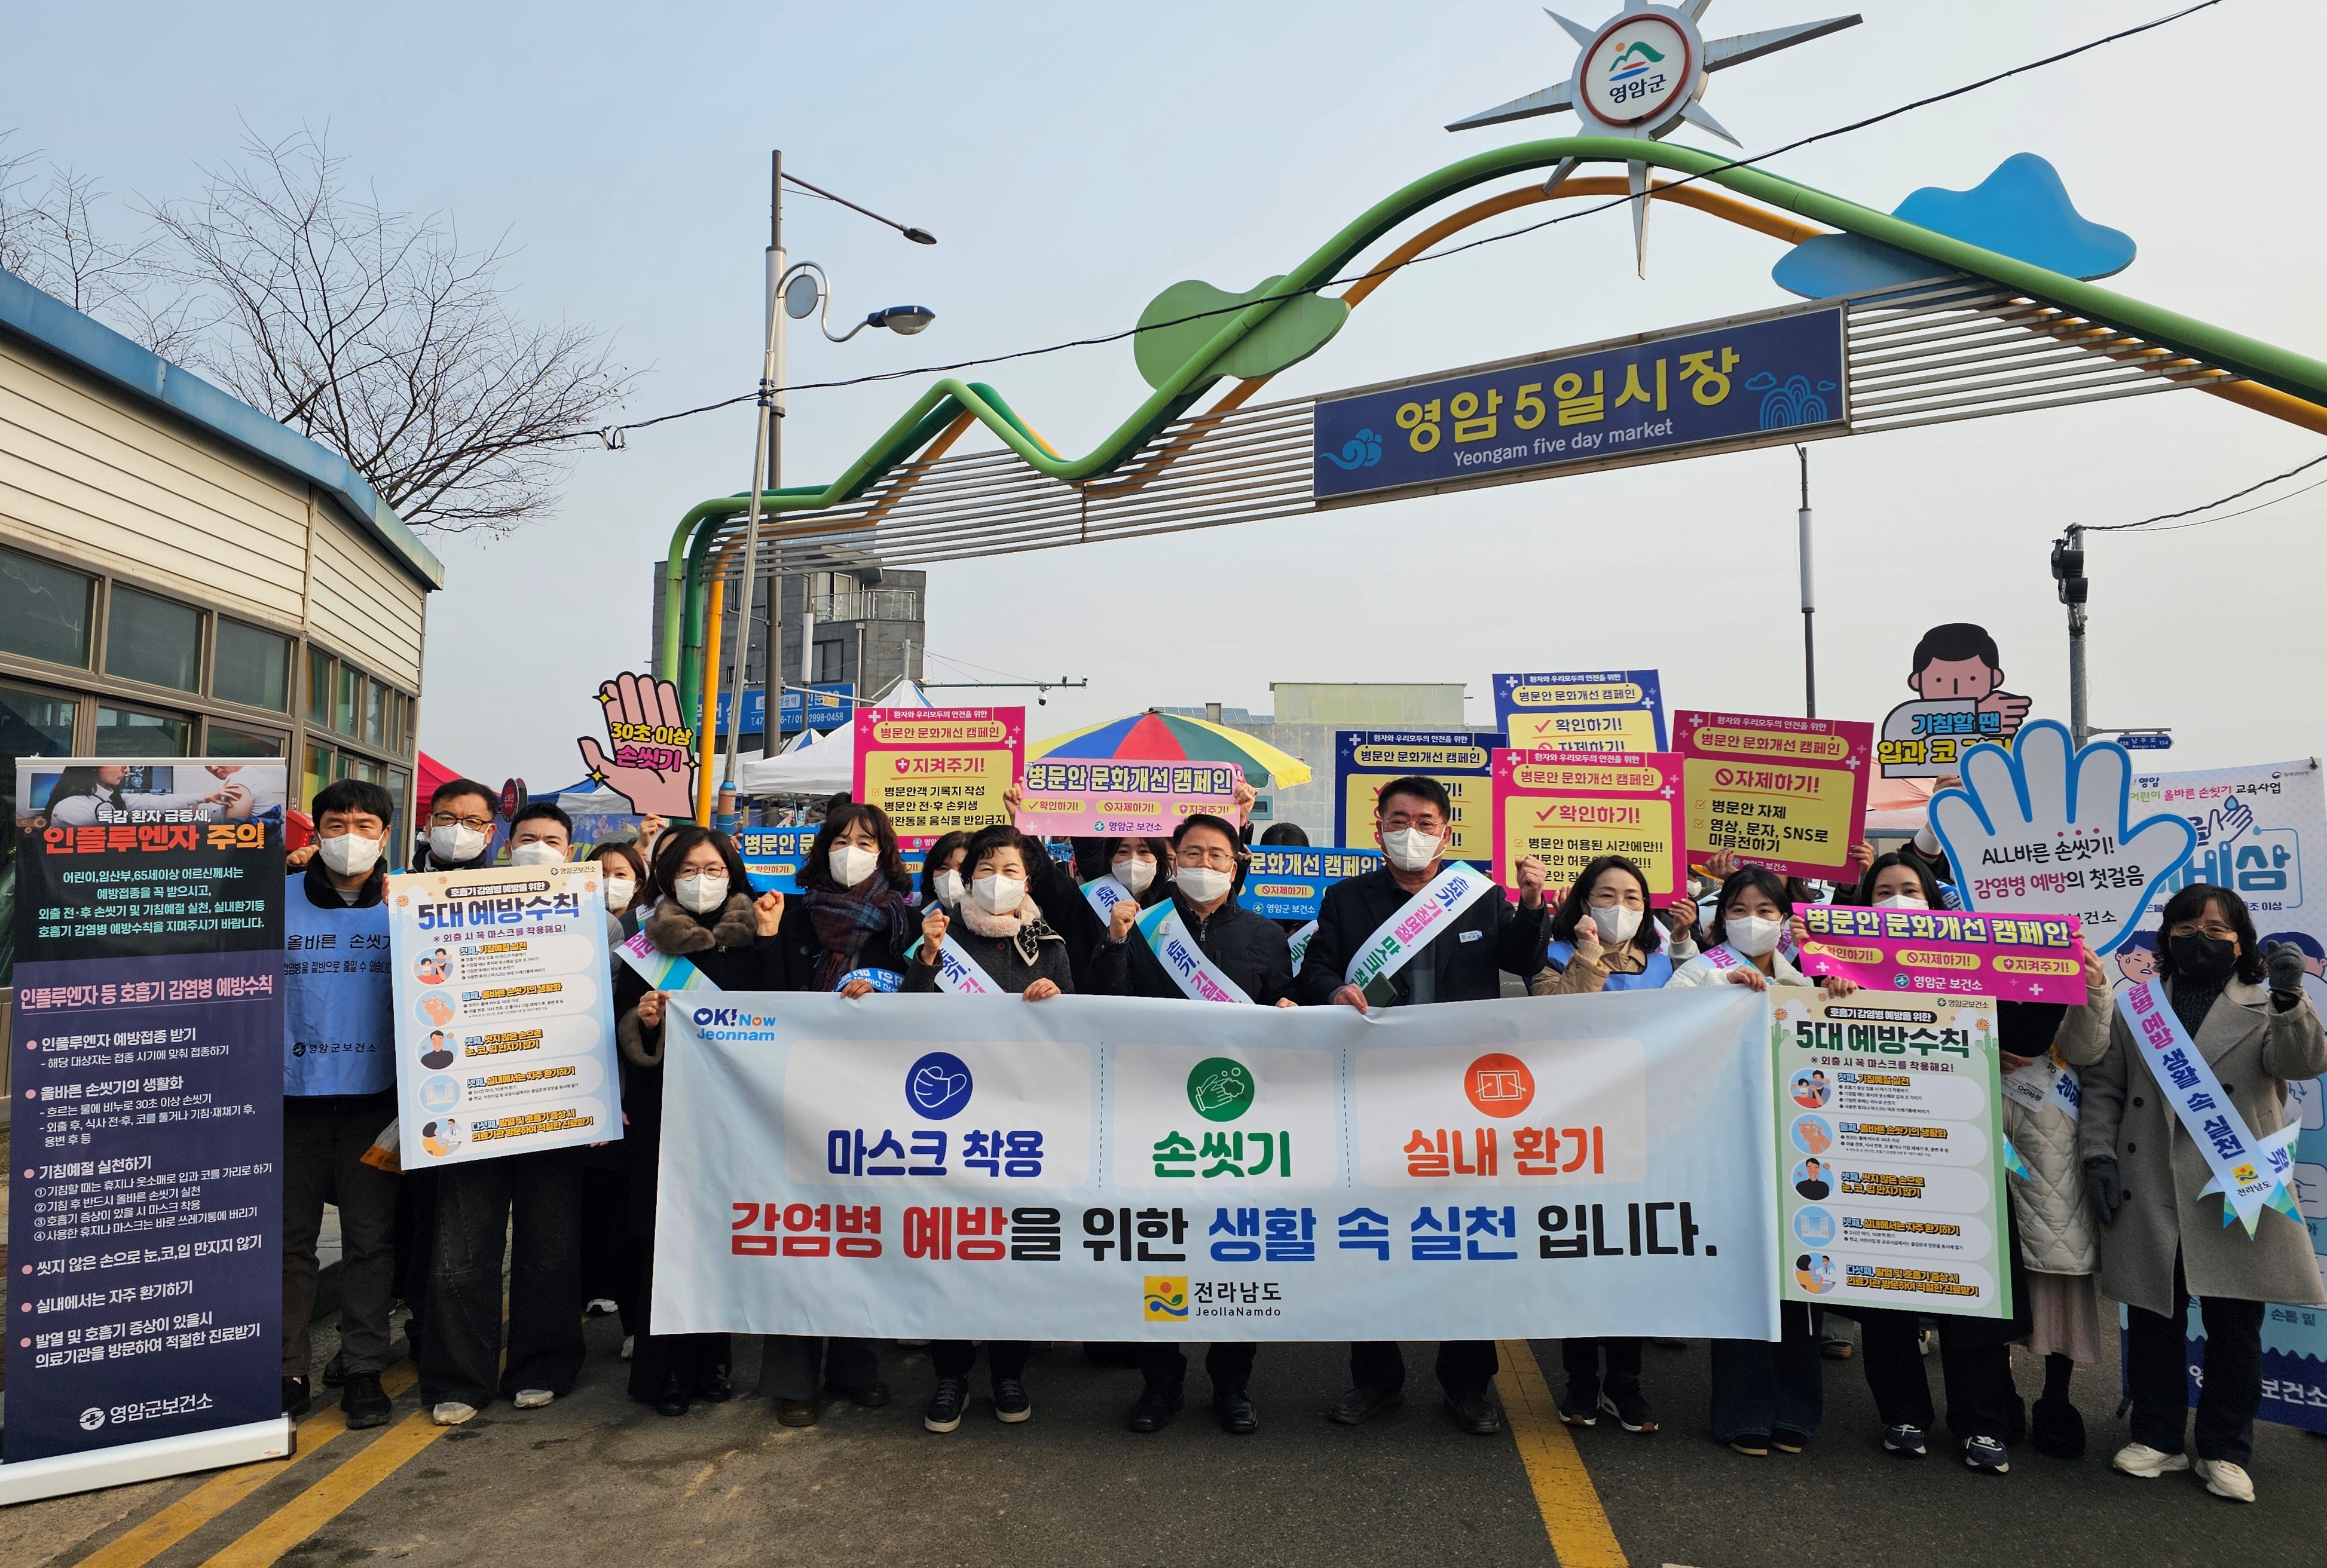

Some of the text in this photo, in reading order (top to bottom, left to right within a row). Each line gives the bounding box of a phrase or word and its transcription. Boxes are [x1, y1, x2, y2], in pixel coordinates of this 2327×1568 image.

[1610, 74, 1666, 103] 영암군
[1453, 417, 1674, 467] Yeongam five day market
[1519, 688, 1635, 702] 병문안 문화개선 캠페인
[880, 726, 999, 738] 병문안 문화개선 캠페인
[1556, 717, 1622, 732] 확인하기!
[1913, 712, 2000, 735] 기침할 땐
[611, 723, 692, 746] 30초 이상
[1701, 733, 1840, 755] 병문안 문화개선 캠페인
[616, 746, 682, 771] 손씻기
[1878, 740, 1957, 765] 입과 코
[913, 758, 984, 773] 지켜주기!
[1027, 764, 1233, 795] 병문안 문화개선 캠페인
[1735, 770, 1820, 794] 자제하기!
[2139, 777, 2160, 788] 영암
[885, 786, 985, 797] 병문안객 기록지 작성
[2164, 789, 2195, 801] 올바른
[2199, 785, 2232, 798] 손씻기
[2236, 782, 2281, 794] 교육사업
[885, 801, 978, 811] 병문안 전·후 손위생
[1039, 801, 1079, 811] 확인하기!
[1114, 802, 1154, 812] 자제하기!
[1559, 806, 1640, 823] 확인하기!
[1712, 800, 1787, 819] 병문안 자제
[98, 809, 211, 823] 독감 환자 급증세,
[1109, 822, 1162, 832] 영암군 보건소
[1710, 819, 1828, 843] 영상, 문자, SNS로
[43, 821, 265, 855] 인플루엔자 주의
[1528, 838, 1663, 853] 병문안 허용된 시간에만!!
[1708, 834, 1780, 853] 마음전하기
[1982, 837, 2115, 865] ALL바른 손씻기!
[560, 866, 596, 875] 영암군보건소
[1249, 852, 1319, 877] 문화개선
[451, 882, 545, 897] 호흡기 감염병 예방을 위한
[1271, 886, 1307, 896] 자제하기!
[1974, 865, 2145, 899] 감염병 예방의 첫걸음
[418, 893, 579, 930] 5대 예방수칙
[1267, 904, 1315, 914] 영암군 보건소
[443, 933, 462, 942] 외출
[465, 932, 473, 941] 시
[488, 927, 524, 939] 마스크를
[527, 924, 567, 936] 착용해요!
[1805, 907, 2071, 949] 병문안 문화개선 캠페인
[288, 934, 336, 950] 올바른
[1362, 935, 1401, 975] 마스크
[1919, 953, 1971, 967] 자제하기!
[311, 961, 340, 973] 절반으로
[344, 960, 357, 972] 줄일
[359, 962, 366, 972] 수
[2016, 958, 2069, 973] 지켜주기!
[20, 975, 273, 1010] 인플루엔자 등 호흡기 감염병 예방수칙
[1913, 976, 1983, 991] 영암군 보건소
[1948, 999, 1989, 1009] 영암군보건소
[693, 1007, 776, 1028] OK! Now
[1830, 1007, 1931, 1022] 호흡기 감염병 예방을 위한
[42, 1027, 197, 1052] 인플루엔자 예방접종 받기
[696, 1028, 775, 1042] Jeonnam
[1796, 1020, 1969, 1058] 5대 예방수칙
[309, 1043, 376, 1053] 영암군보건소
[41, 1076, 184, 1101] 올바른 손씻기의 생활화
[2141, 1011, 2246, 1160] 예방 생활 속 실천
[827, 1128, 1044, 1177] 마스크 착용
[1152, 1131, 1291, 1178] 손씻기
[1403, 1126, 1605, 1177] 실내 환기
[39, 1155, 152, 1180] 기침예절 실천하기
[2236, 1181, 2273, 1198] 전라남도
[731, 1202, 1718, 1262] 감염병 예방을 위한 생활 속 실천 입니다.
[36, 1280, 193, 1314] 실내에서는 자주 환기하기
[1194, 1281, 1282, 1304] 전라남도
[1195, 1306, 1282, 1318] JeollaNamdo
[110, 1392, 213, 1425] 영암군보건소
